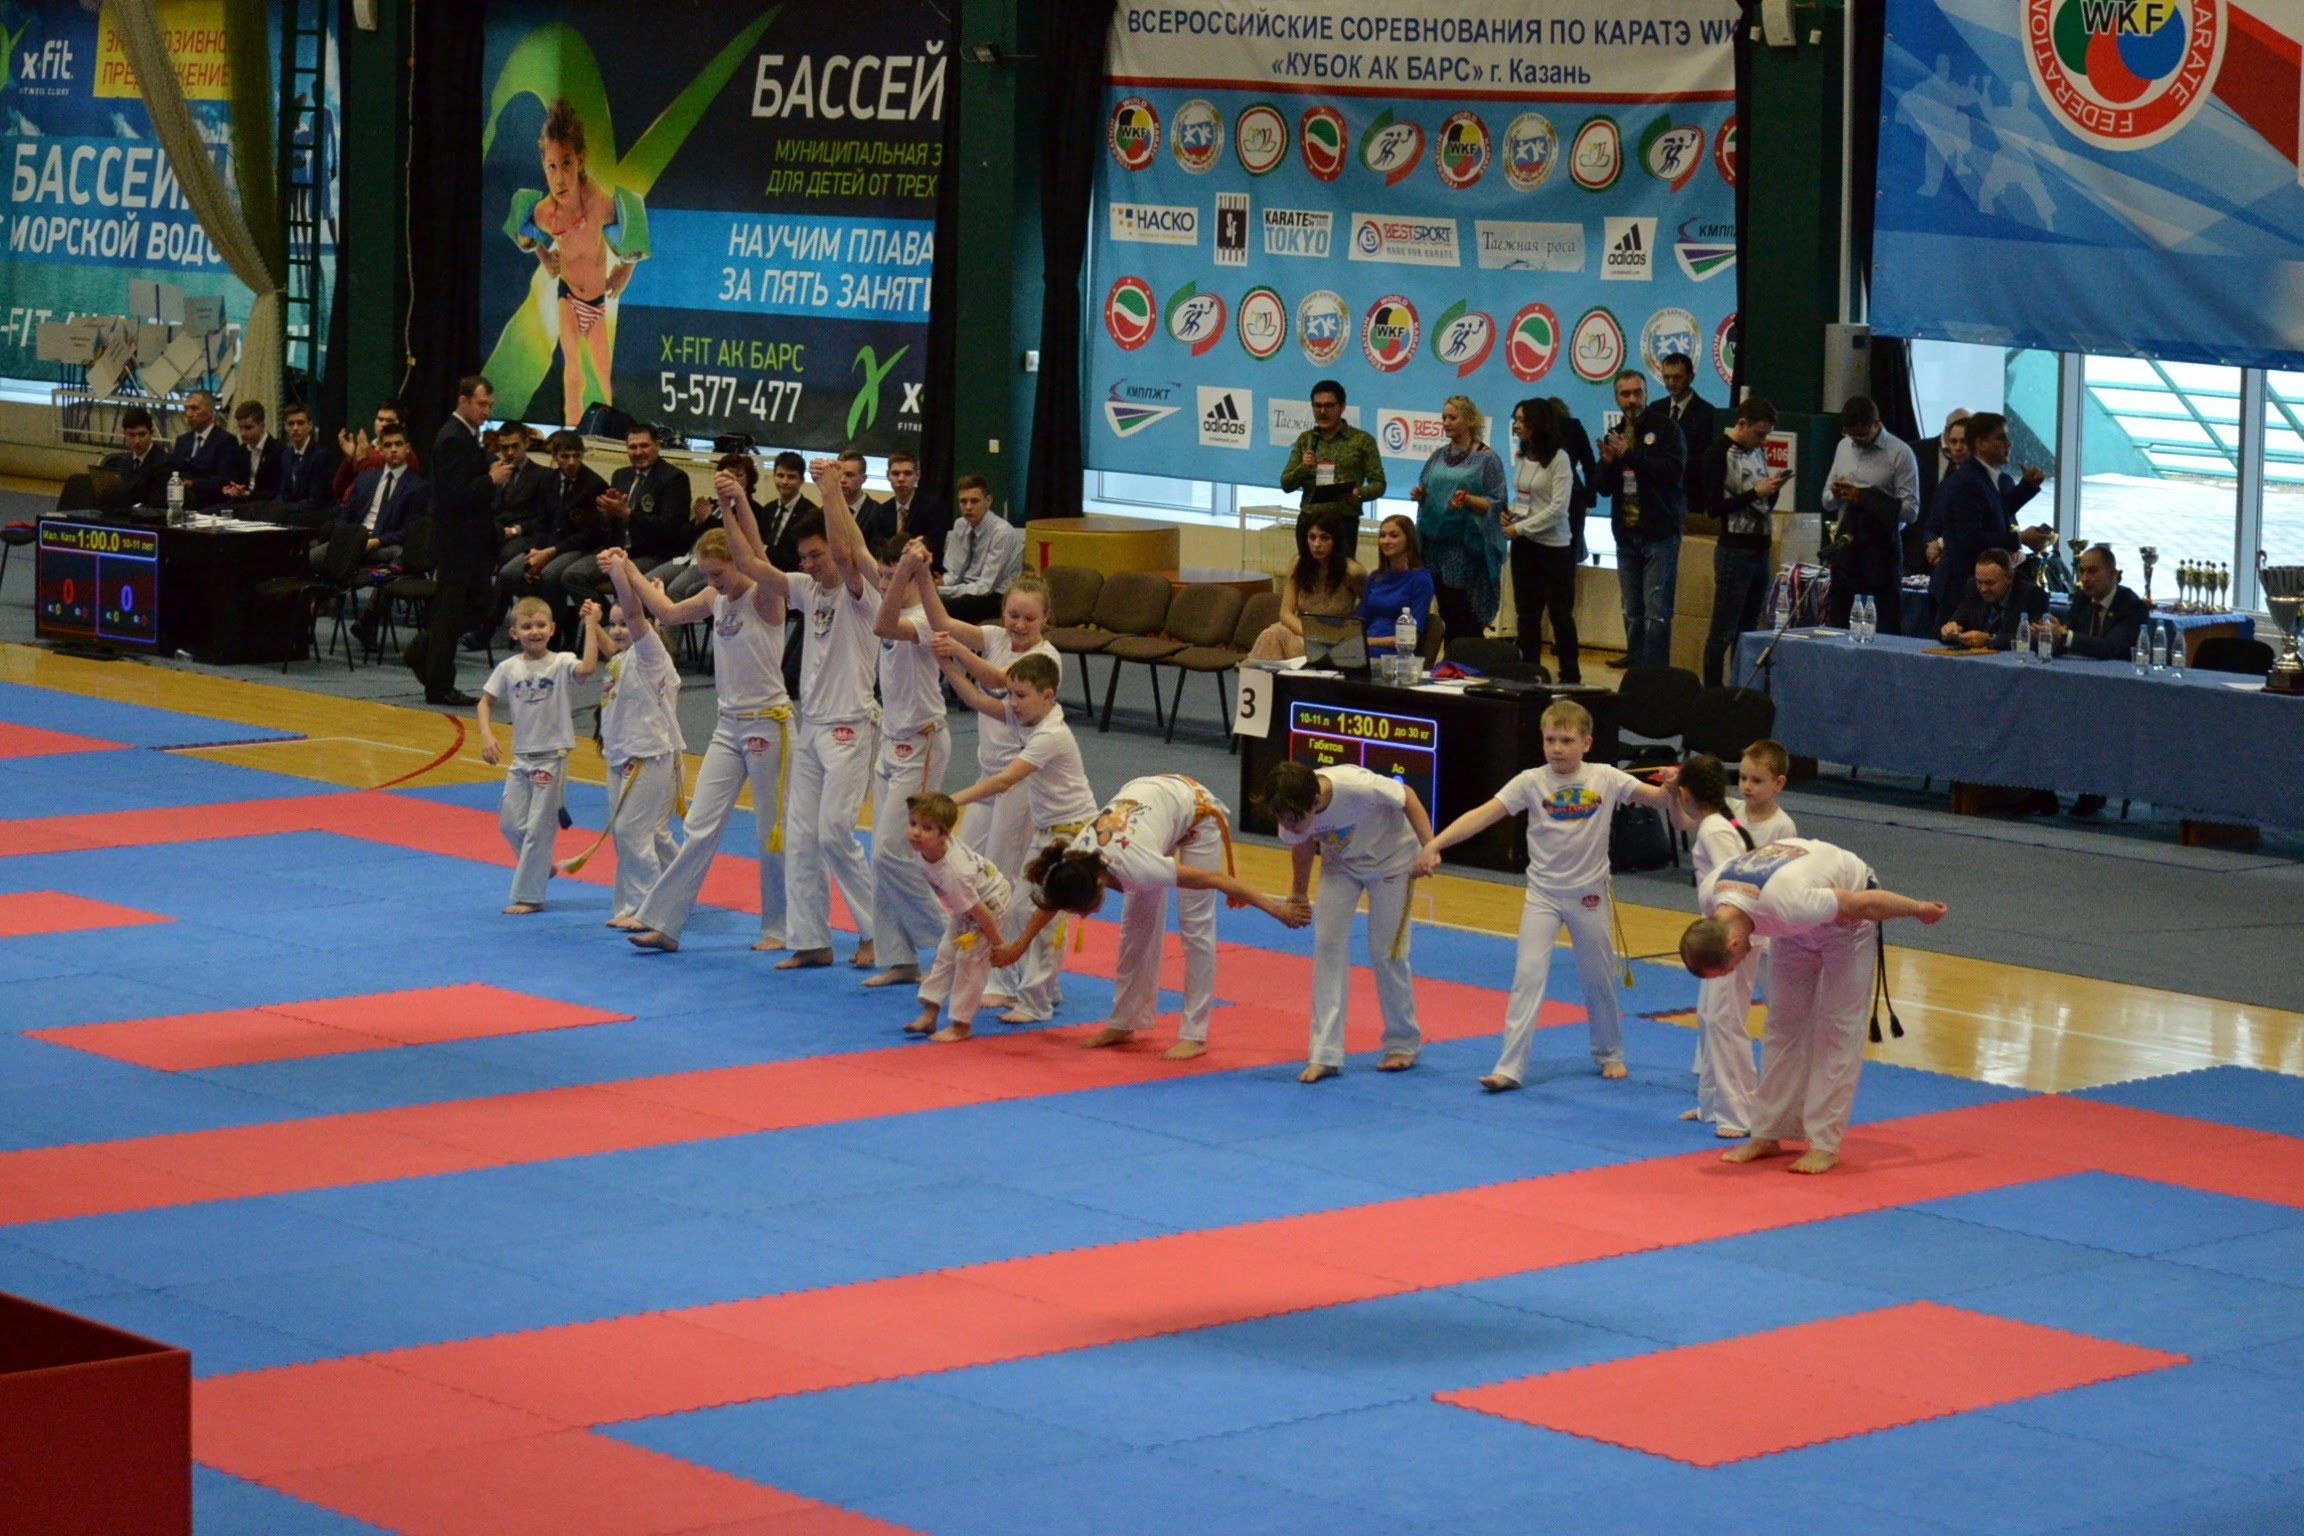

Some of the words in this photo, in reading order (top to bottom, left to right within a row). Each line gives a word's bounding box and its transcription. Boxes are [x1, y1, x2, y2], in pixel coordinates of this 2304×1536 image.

[1128, 8, 1333, 41] ВСЕРОССИЙСКИЕ
[1340, 17, 1542, 45] СОРЕВНОВАНИЯ
[1550, 19, 1586, 45] ПО
[1594, 19, 1692, 45] КАРАТЭ
[2081, 0, 2164, 36] WKF
[2170, 0, 2213, 107] ARATE
[752, 40, 948, 121] БАССЕЙ
[1272, 52, 1364, 80] «КУБОК
[1367, 56, 1399, 81] АК
[1407, 56, 1484, 82] БАРС»
[1490, 64, 1502, 82] г.
[1509, 58, 1591, 85] Казань
[775, 139, 928, 167] МУНИЦИПАЛЬНАЯ
[1450, 142, 1478, 155] WKF
[766, 170, 804, 197] ДЛЯ
[806, 168, 865, 198] ДЕТЕЙ
[868, 173, 891, 196] ОТ
[896, 174, 938, 197] ТРЕХ
[1137, 210, 1195, 232] НАСКО
[1265, 210, 1309, 227] KARATE
[1699, 224, 1735, 238] КМПП
[10, 211, 140, 259] МОРСКОЙ
[728, 223, 842, 262] НАУЧИМ
[847, 228, 934, 266] ПЛАВА
[1265, 226, 1329, 254] TOKYO
[1482, 231, 1540, 252] Таежная
[1546, 239, 1577, 258] роса
[1608, 250, 1647, 266] adidas
[718, 267, 752, 302] ЗА
[760, 269, 829, 306] ПЯТЬ
[1380, 296, 1409, 306] WORLD
[1376, 324, 1405, 339] WKF
[717, 339, 744, 368] АК
[750, 341, 804, 373] БАРС
[661, 371, 803, 424] 5-577-477
[1126, 385, 1172, 401] КМППЖТ
[1203, 419, 1246, 435] adidas
[78, 528, 120, 552] 1:00.0
[64, 579, 75, 605] 0
[121, 584, 133, 612] 0
[1240, 687, 1256, 719] 3
[1300, 712, 1321, 725] 10-11
[1337, 711, 1389, 739] 1:30.0
[1394, 727, 1407, 738] до
[1408, 726, 1419, 739] 30
[1420, 731, 1430, 740] кг
[1309, 738, 1344, 753] Габитов
[1317, 752, 1335, 765] Ака
